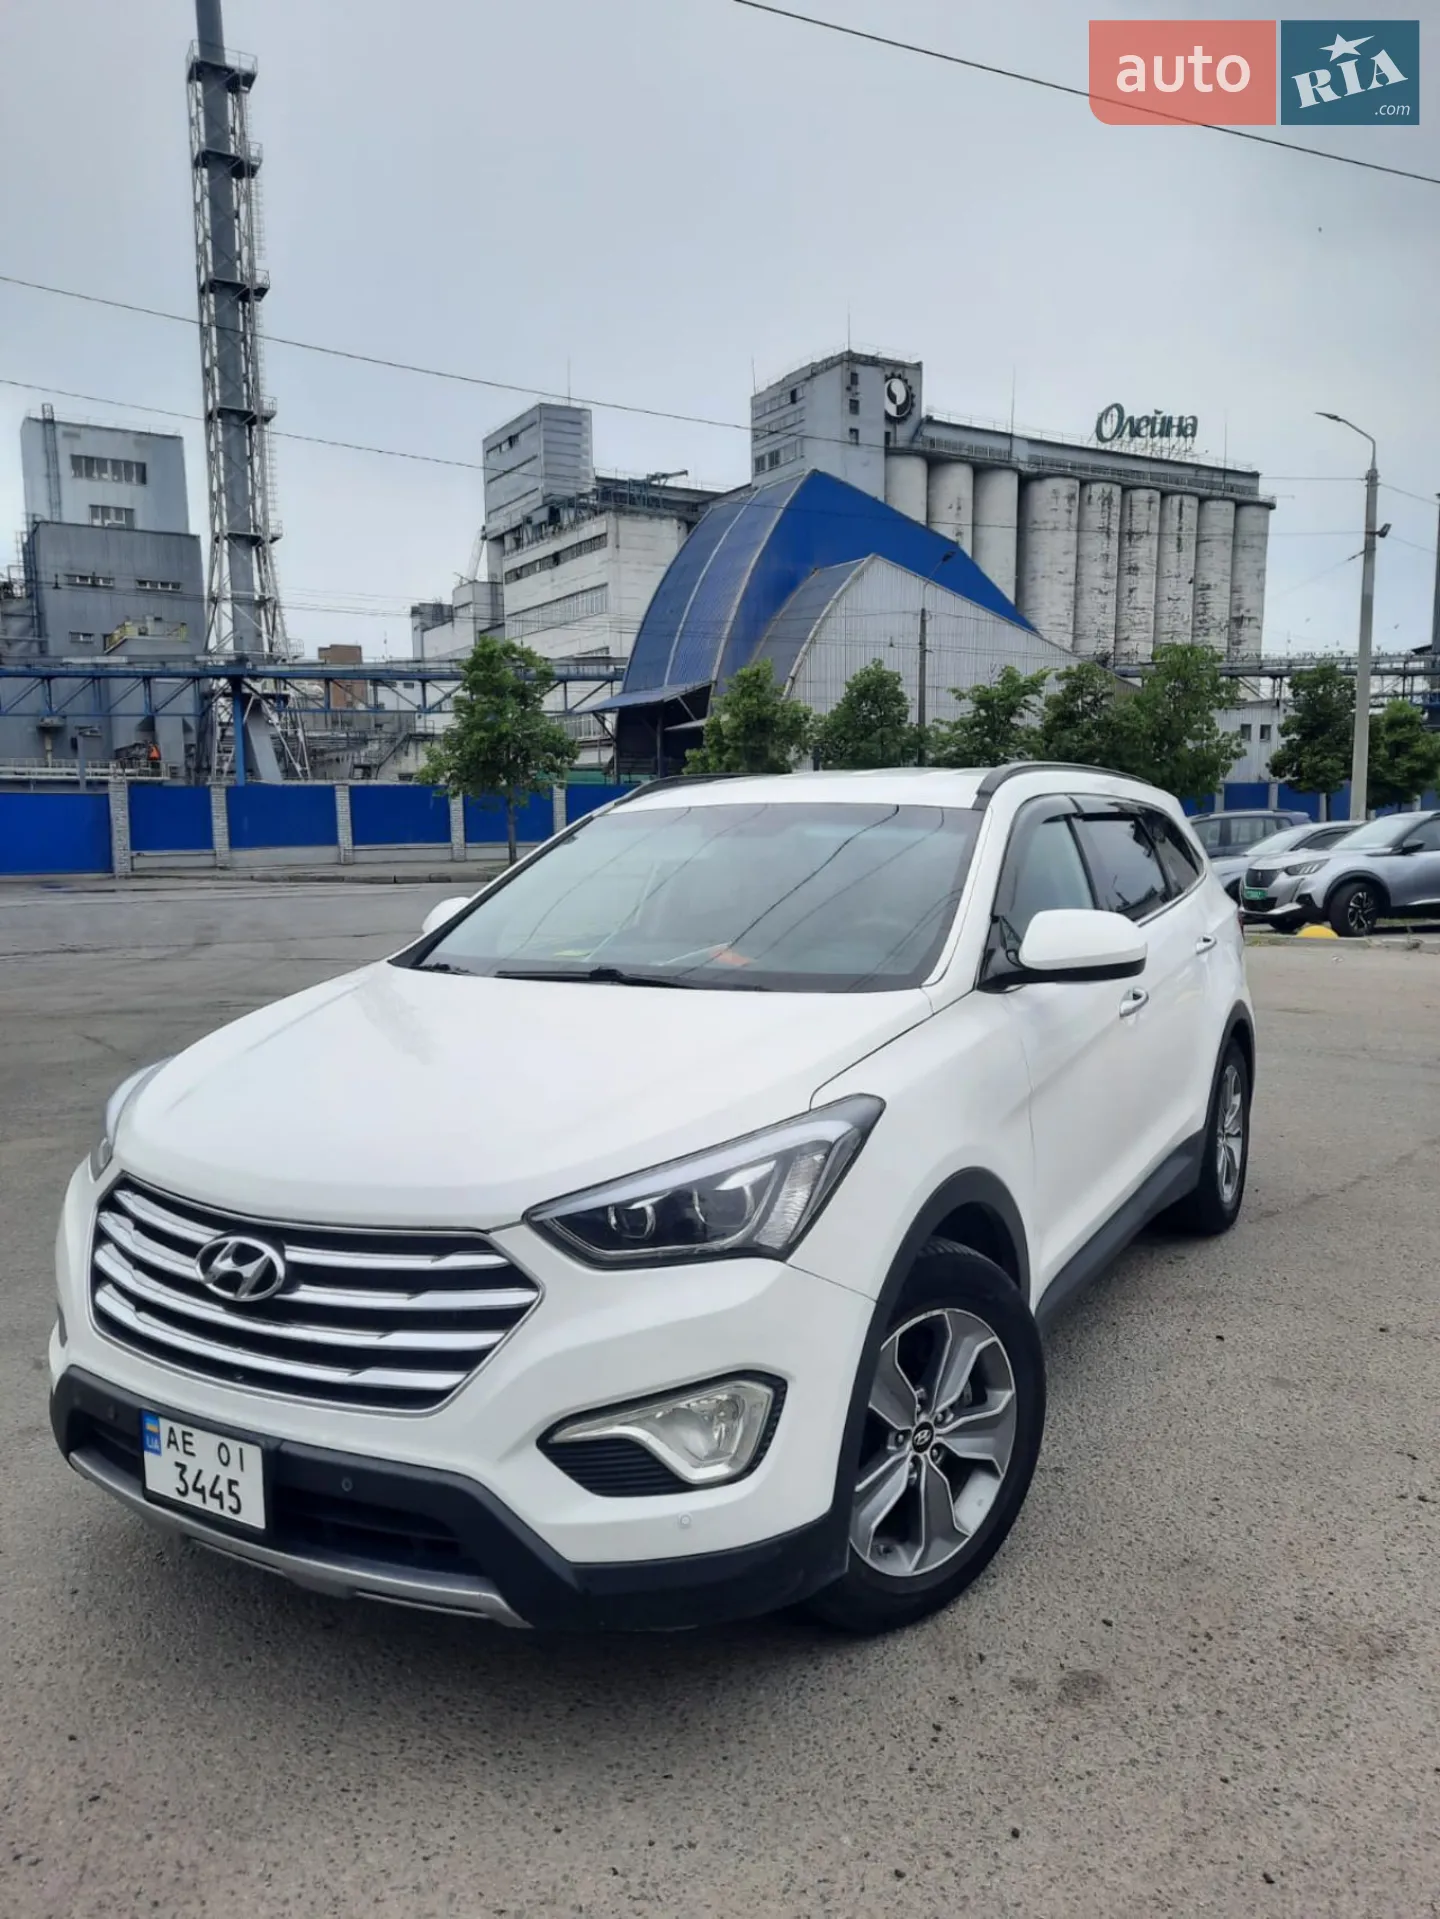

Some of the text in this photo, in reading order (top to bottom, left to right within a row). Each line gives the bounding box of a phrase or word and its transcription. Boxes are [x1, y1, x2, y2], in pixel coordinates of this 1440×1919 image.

[1096, 403, 1198, 443] Олейна
[146, 1435, 160, 1451] UA
[167, 1426, 196, 1457] AE
[174, 1461, 242, 1515] 3445
